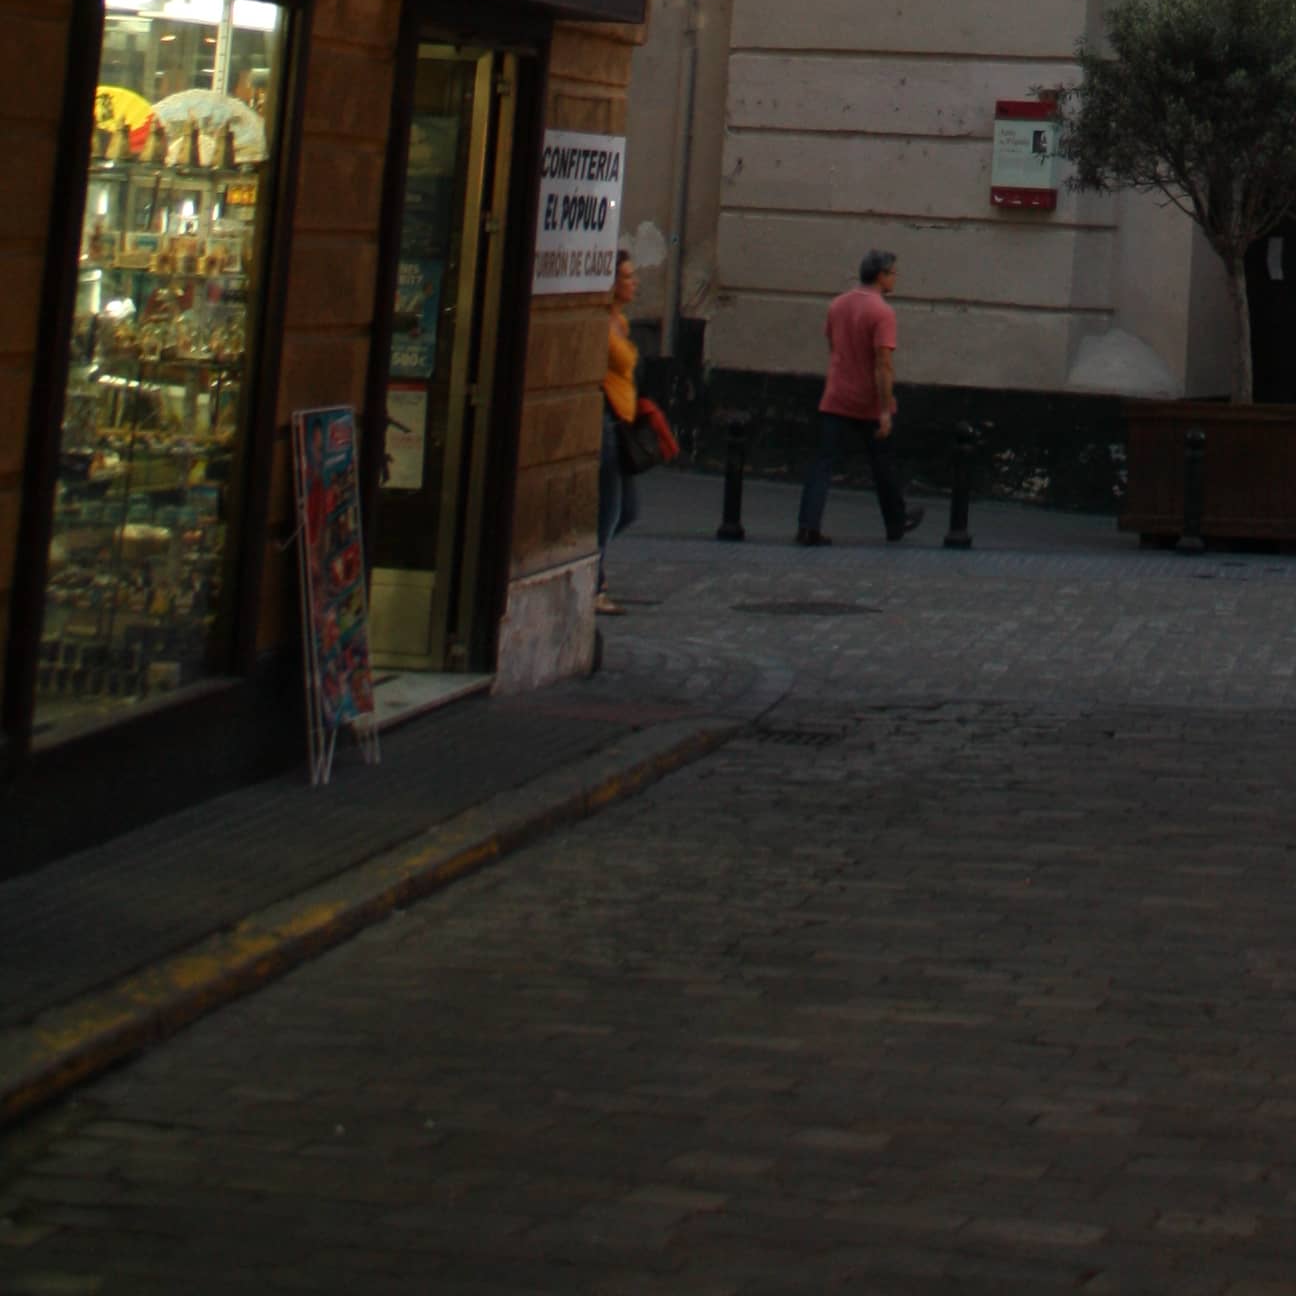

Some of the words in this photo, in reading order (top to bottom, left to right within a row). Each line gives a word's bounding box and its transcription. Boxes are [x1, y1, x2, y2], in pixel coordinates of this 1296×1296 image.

[541, 146, 620, 182] CONFITERIA
[543, 193, 558, 231] EL
[560, 186, 608, 232] PÓPULO
[569, 249, 583, 278] DE
[584, 243, 614, 277] CÁDIZ
